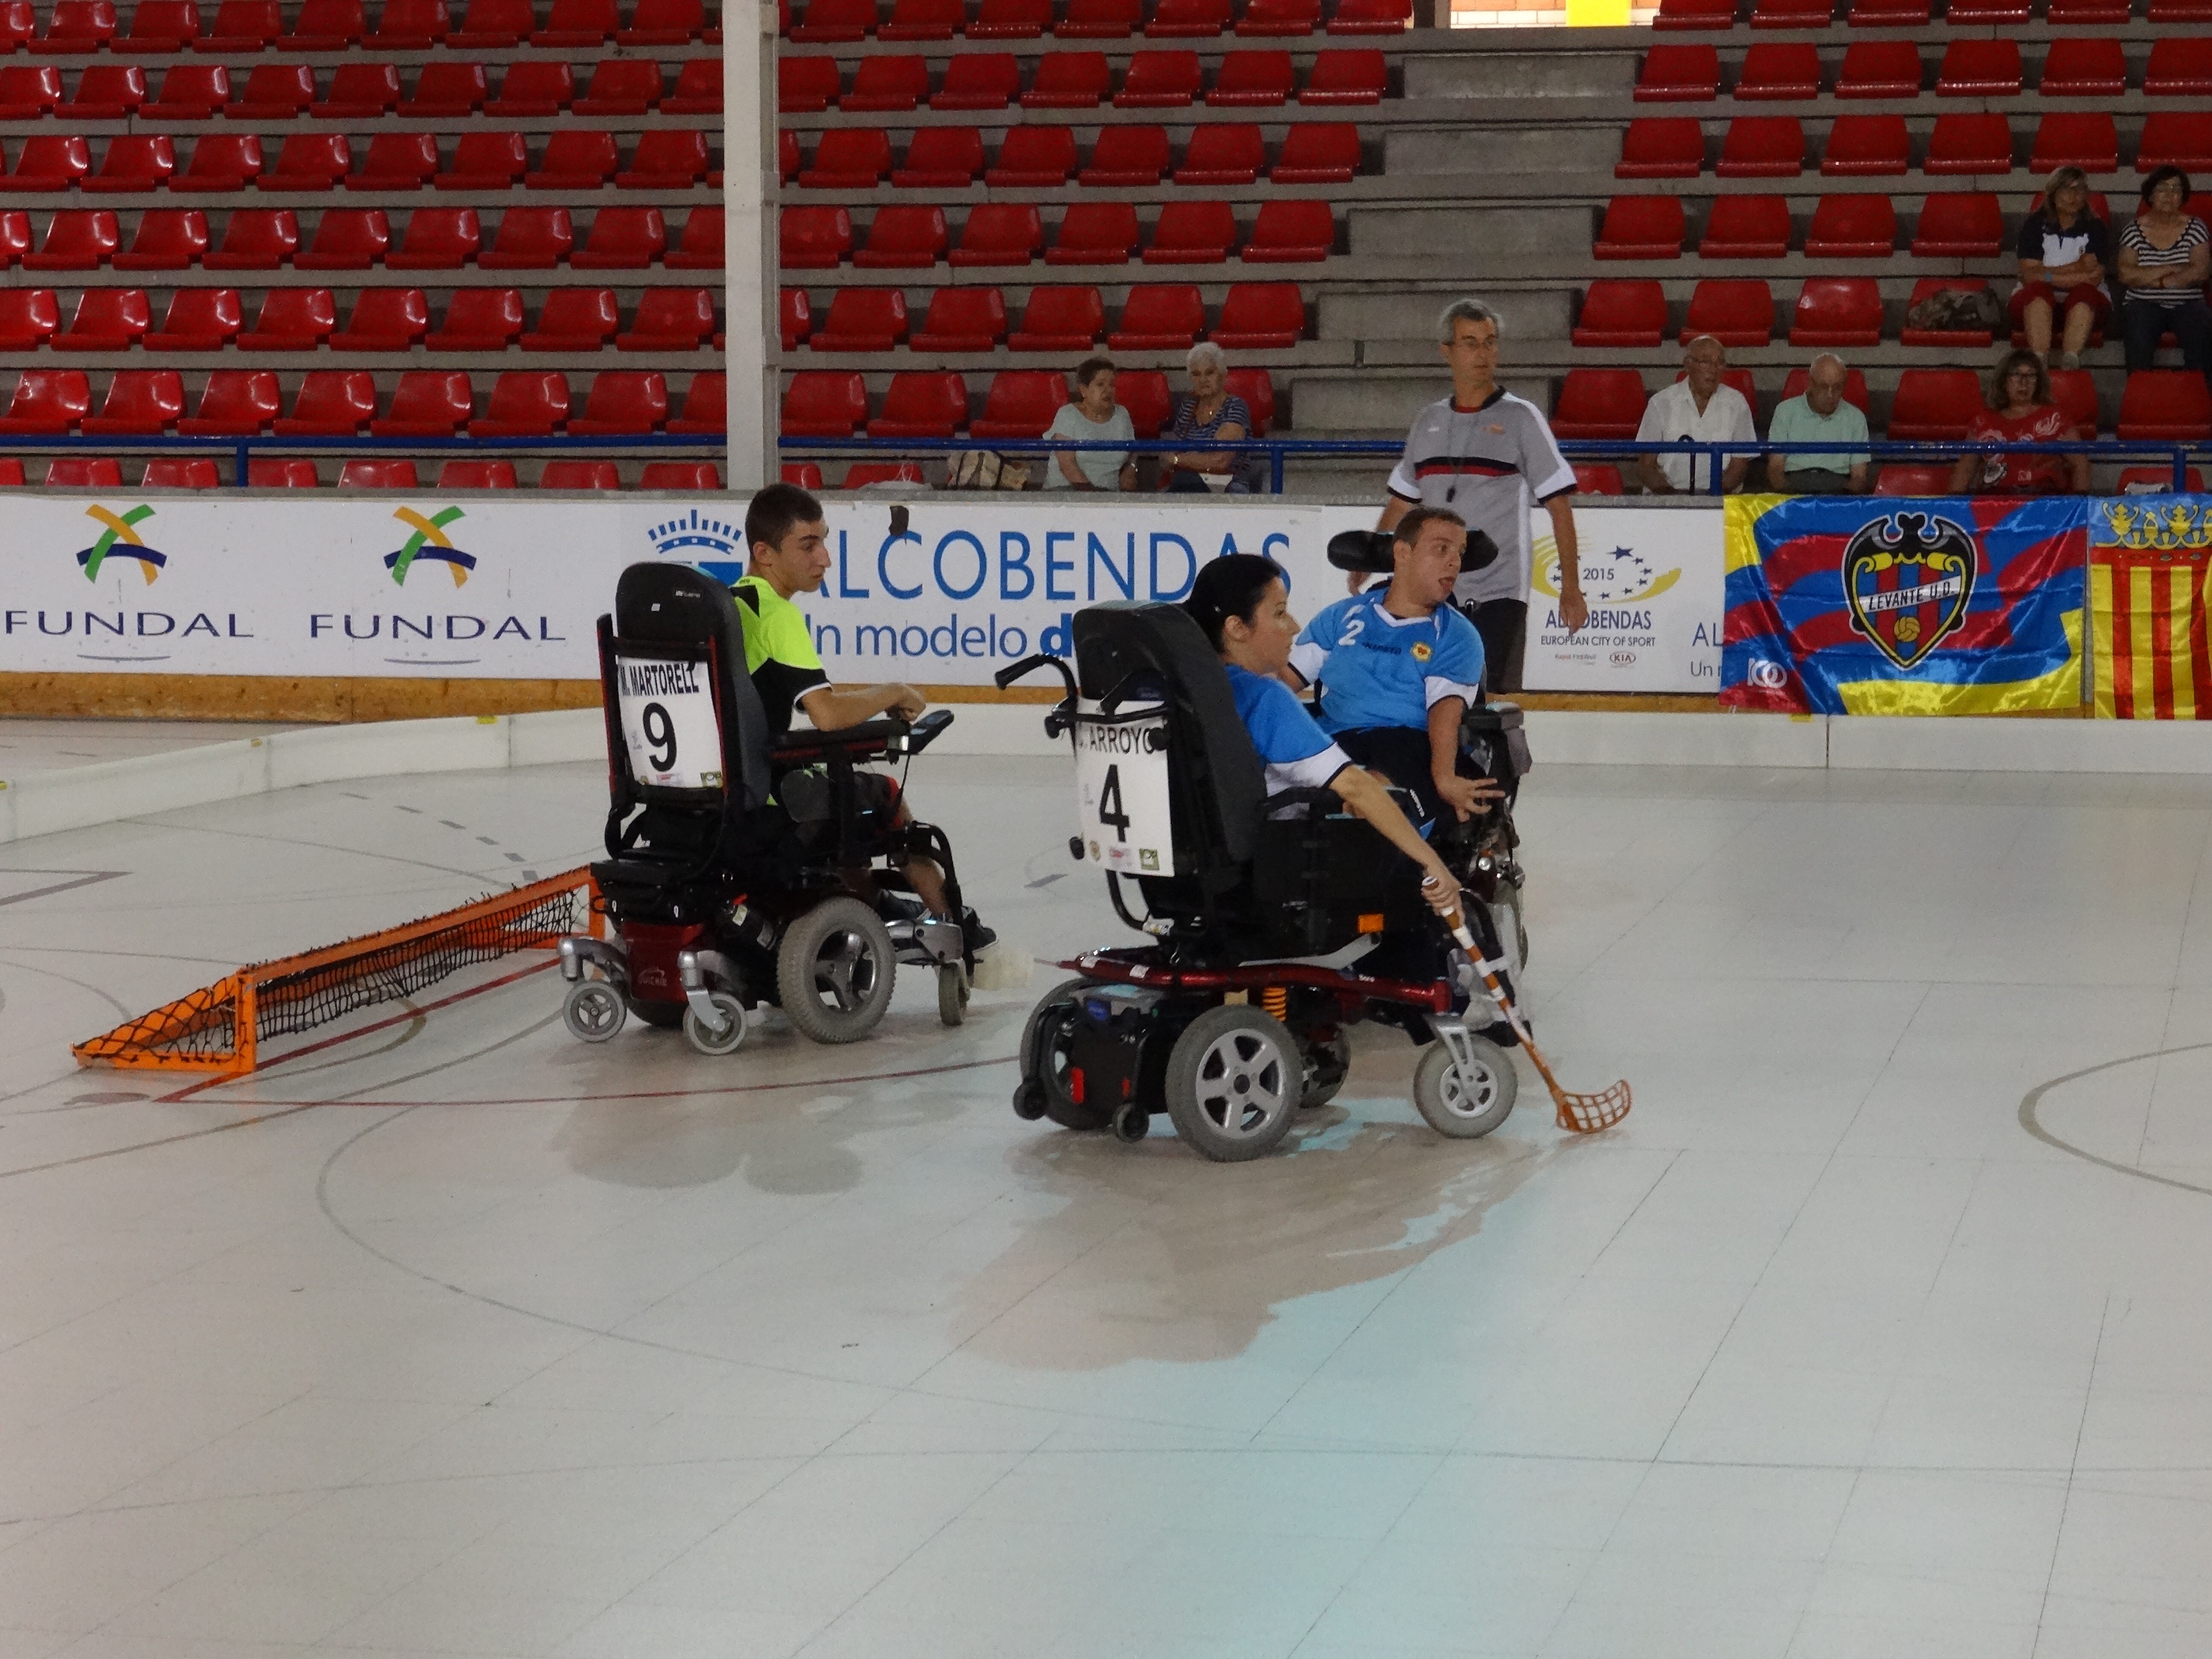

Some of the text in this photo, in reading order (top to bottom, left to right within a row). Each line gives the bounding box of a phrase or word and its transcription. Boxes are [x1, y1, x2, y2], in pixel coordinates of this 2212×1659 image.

[820, 530, 1291, 605] LCOBENDS
[1583, 568, 1614, 580] 2015
[1869, 587, 1924, 611] LEVANTE
[5, 611, 254, 638] FUNDAL
[311, 615, 566, 641] FUNDAL
[1338, 619, 1365, 646] 2
[1545, 609, 1651, 630] ALBENDAS
[856, 613, 1027, 658] modelo
[1541, 635, 1656, 647] EUROPEAN CITY OF SPORT
[1613, 654, 1632, 662] KIA
[629, 663, 700, 696] MARTORELL
[642, 702, 678, 772] 9
[1099, 763, 1131, 843] 4
